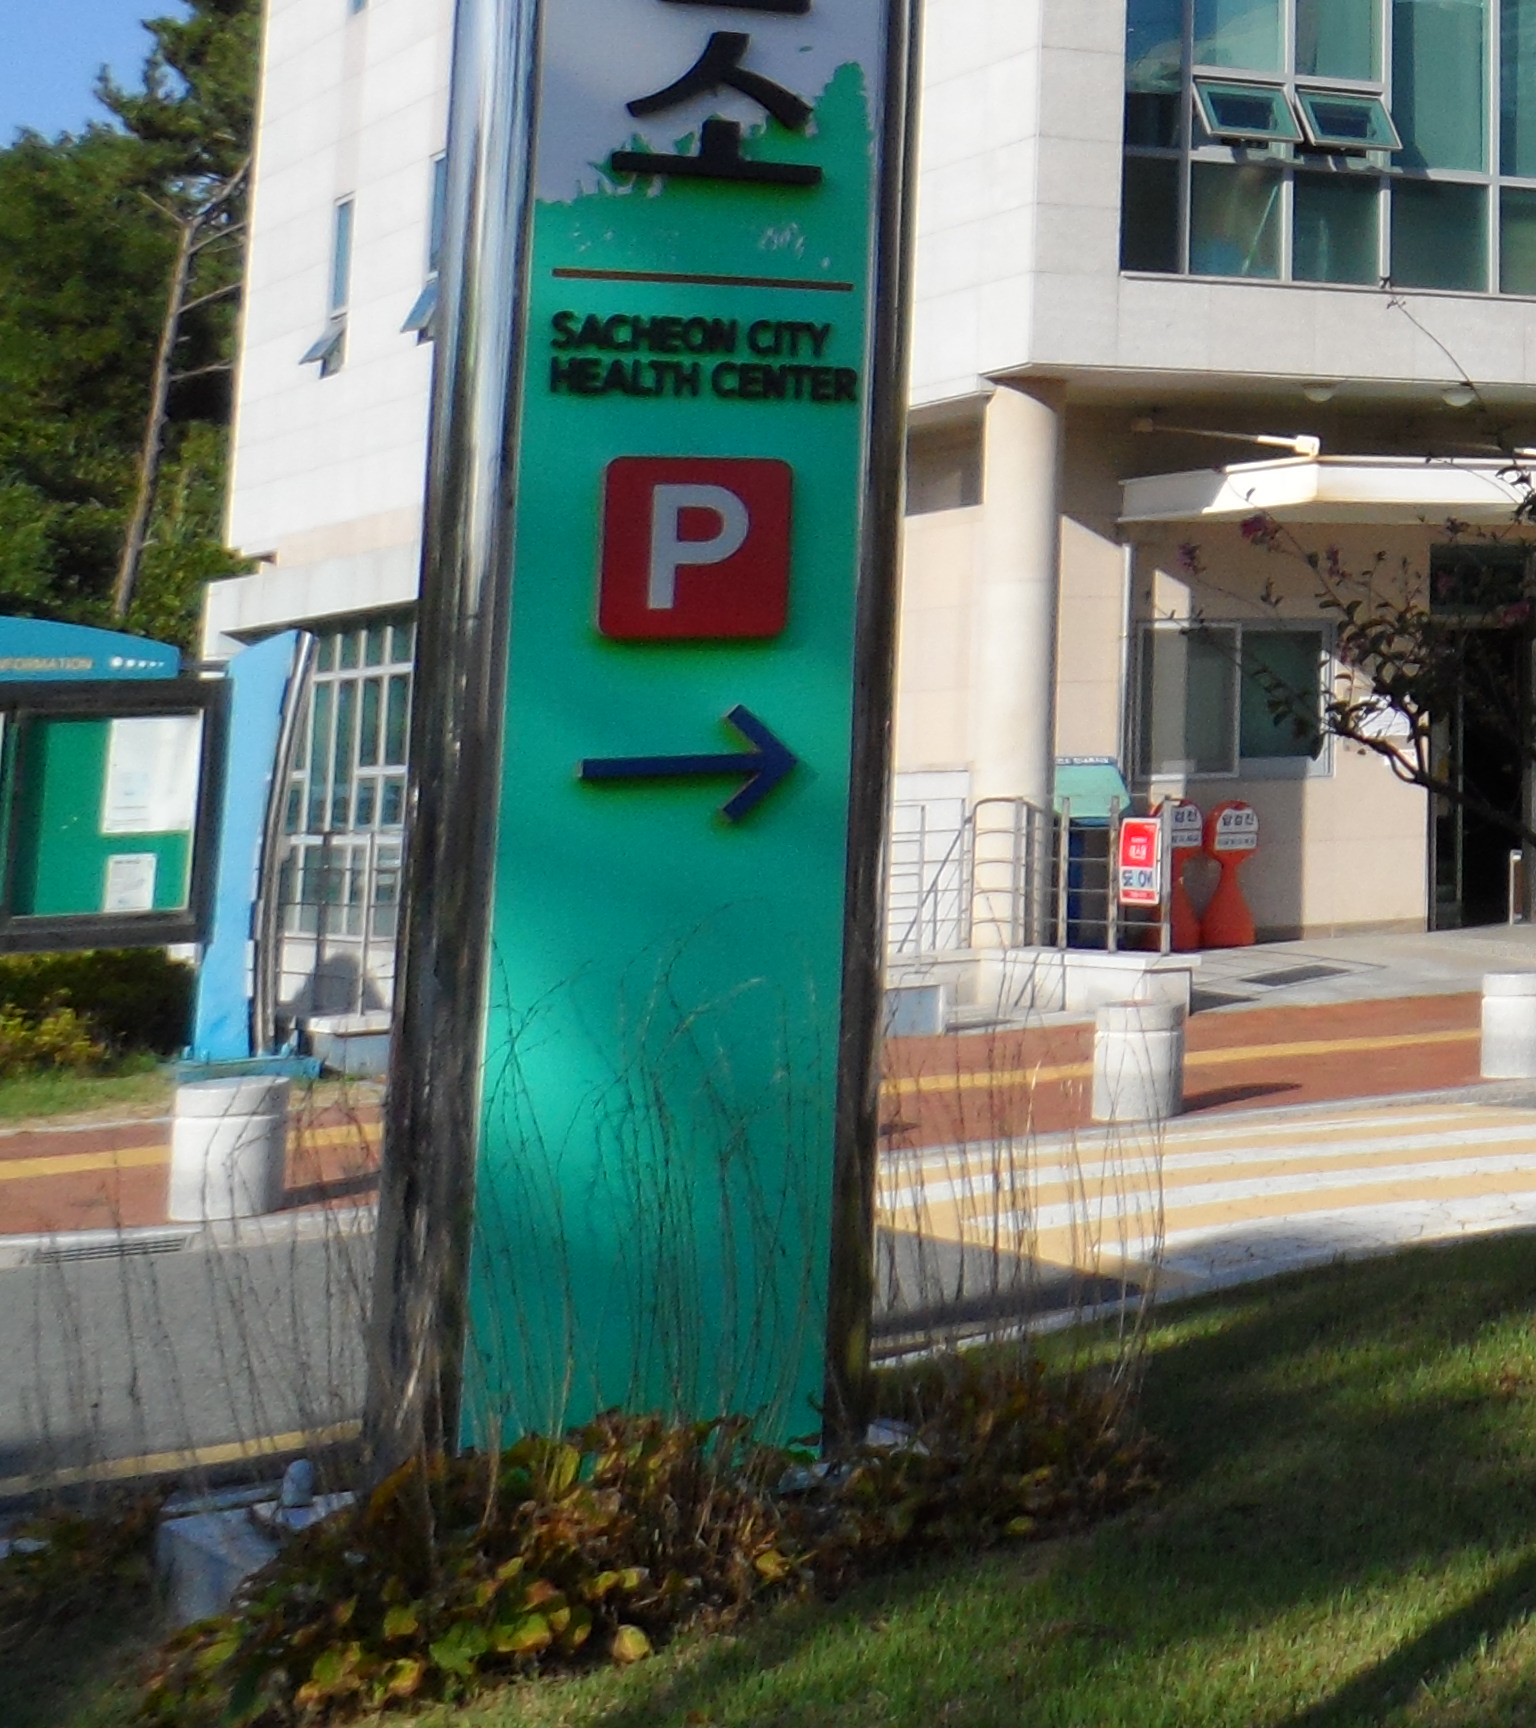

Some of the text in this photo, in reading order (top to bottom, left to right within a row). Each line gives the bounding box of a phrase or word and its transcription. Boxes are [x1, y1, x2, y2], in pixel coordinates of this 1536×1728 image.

[550, 310, 832, 359] SACHEON CITY
[550, 356, 858, 403] HEALTH CENTER
[647, 483, 750, 610] P
